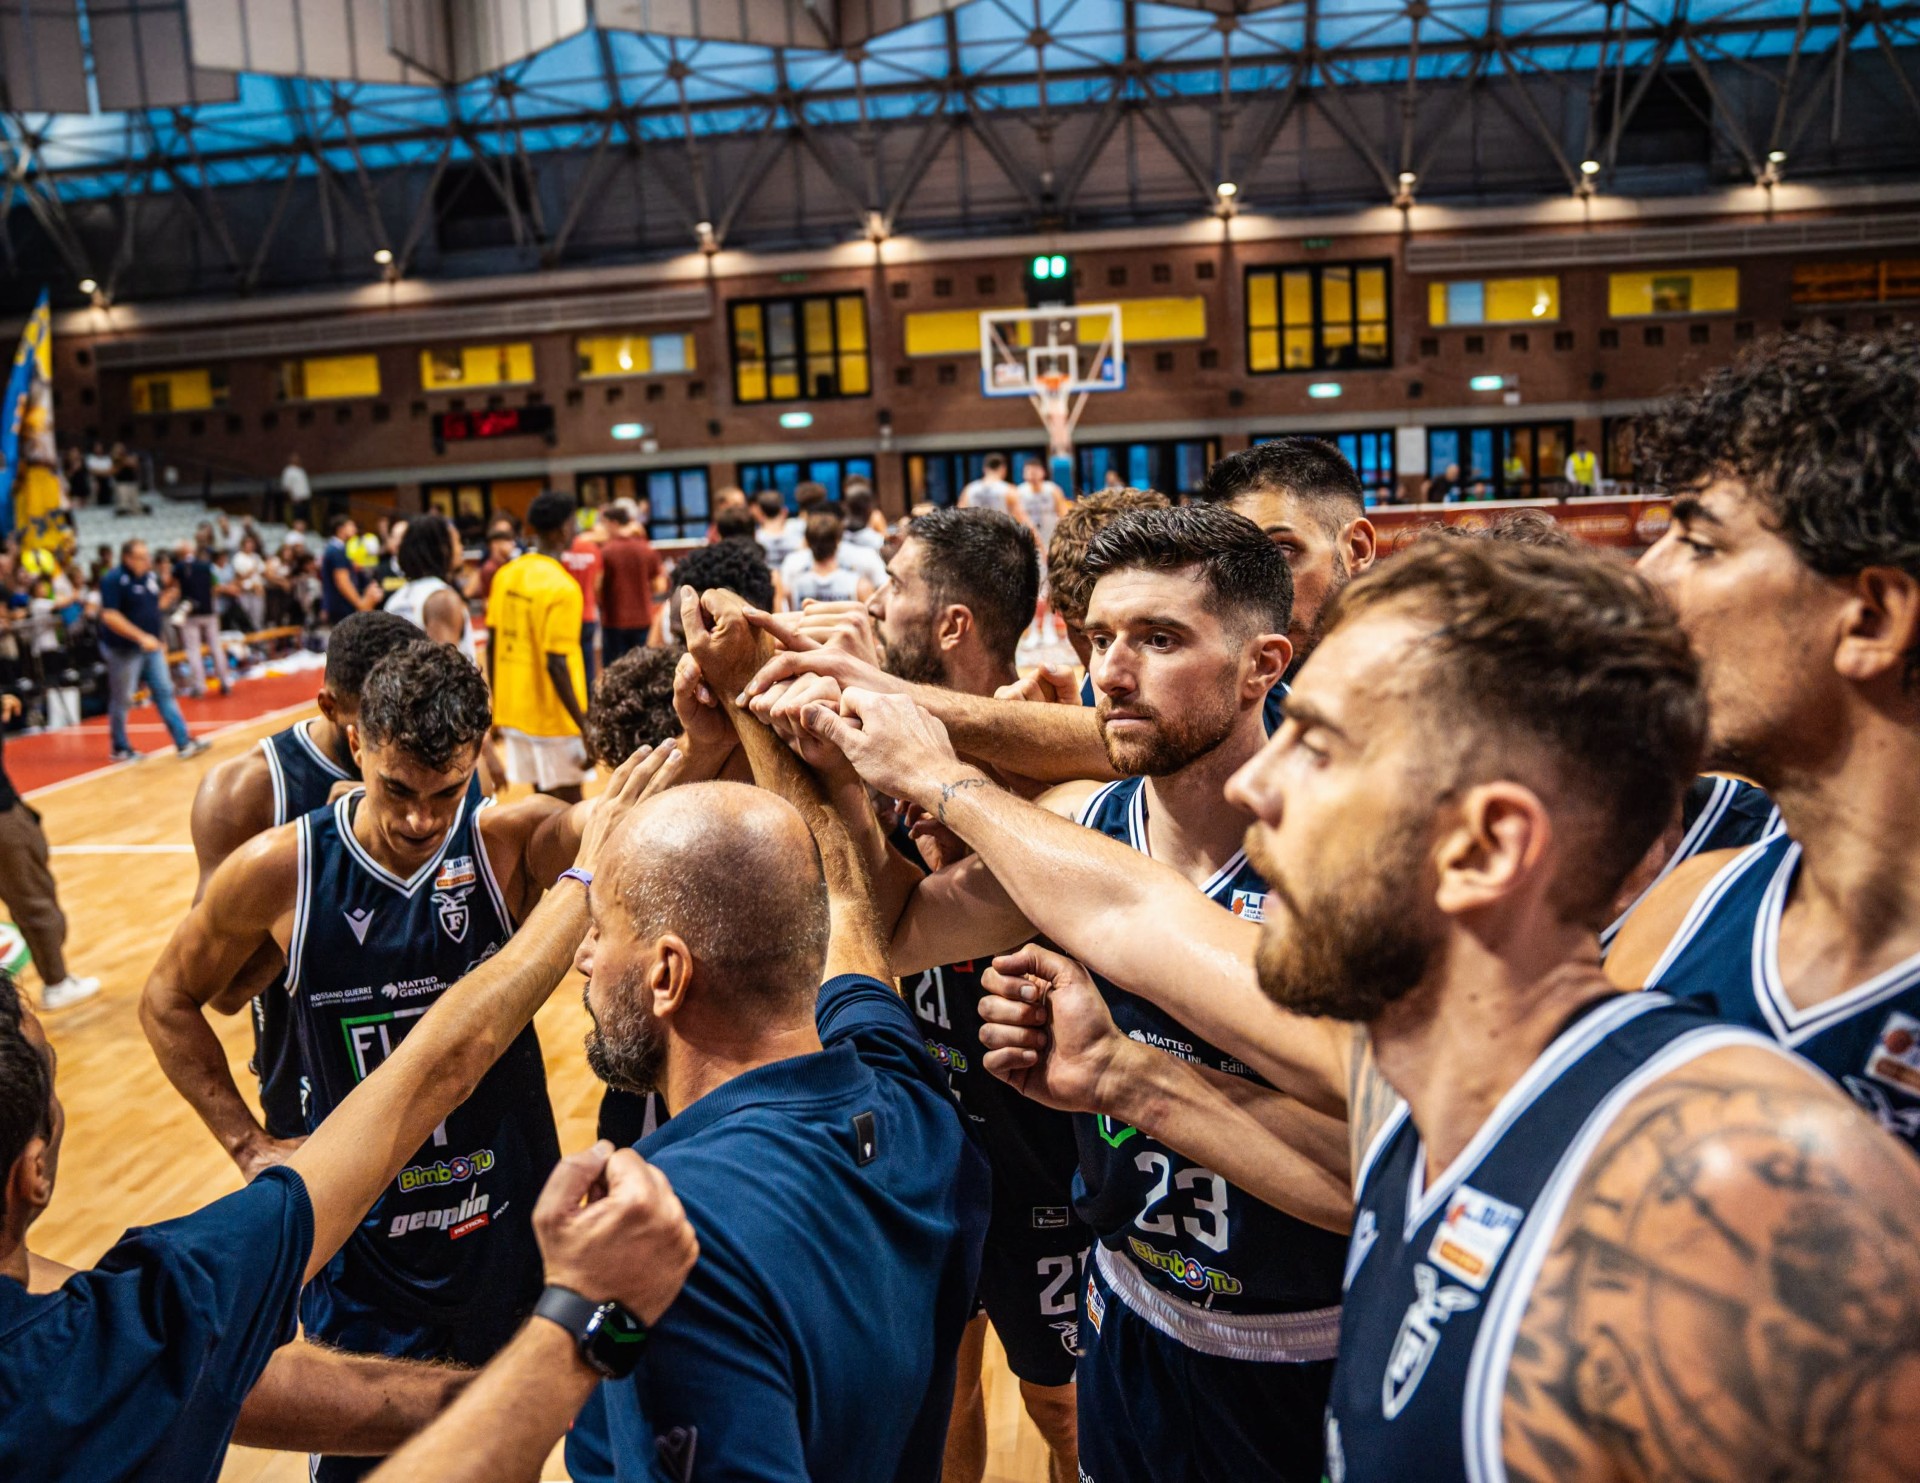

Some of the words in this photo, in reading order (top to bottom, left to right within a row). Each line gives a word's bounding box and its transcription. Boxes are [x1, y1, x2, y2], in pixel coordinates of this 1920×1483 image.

[446, 911, 464, 931] F
[399, 976, 438, 989] MATTEO
[399, 982, 447, 998] GENTILINI
[310, 990, 344, 1002] ROSSANO
[344, 986, 372, 998] GUERRI
[1146, 1032, 1193, 1053] MATTEO
[388, 1182, 490, 1238] geoplin
[1134, 1151, 1229, 1253] 23
[454, 1218, 485, 1235] PETROL
